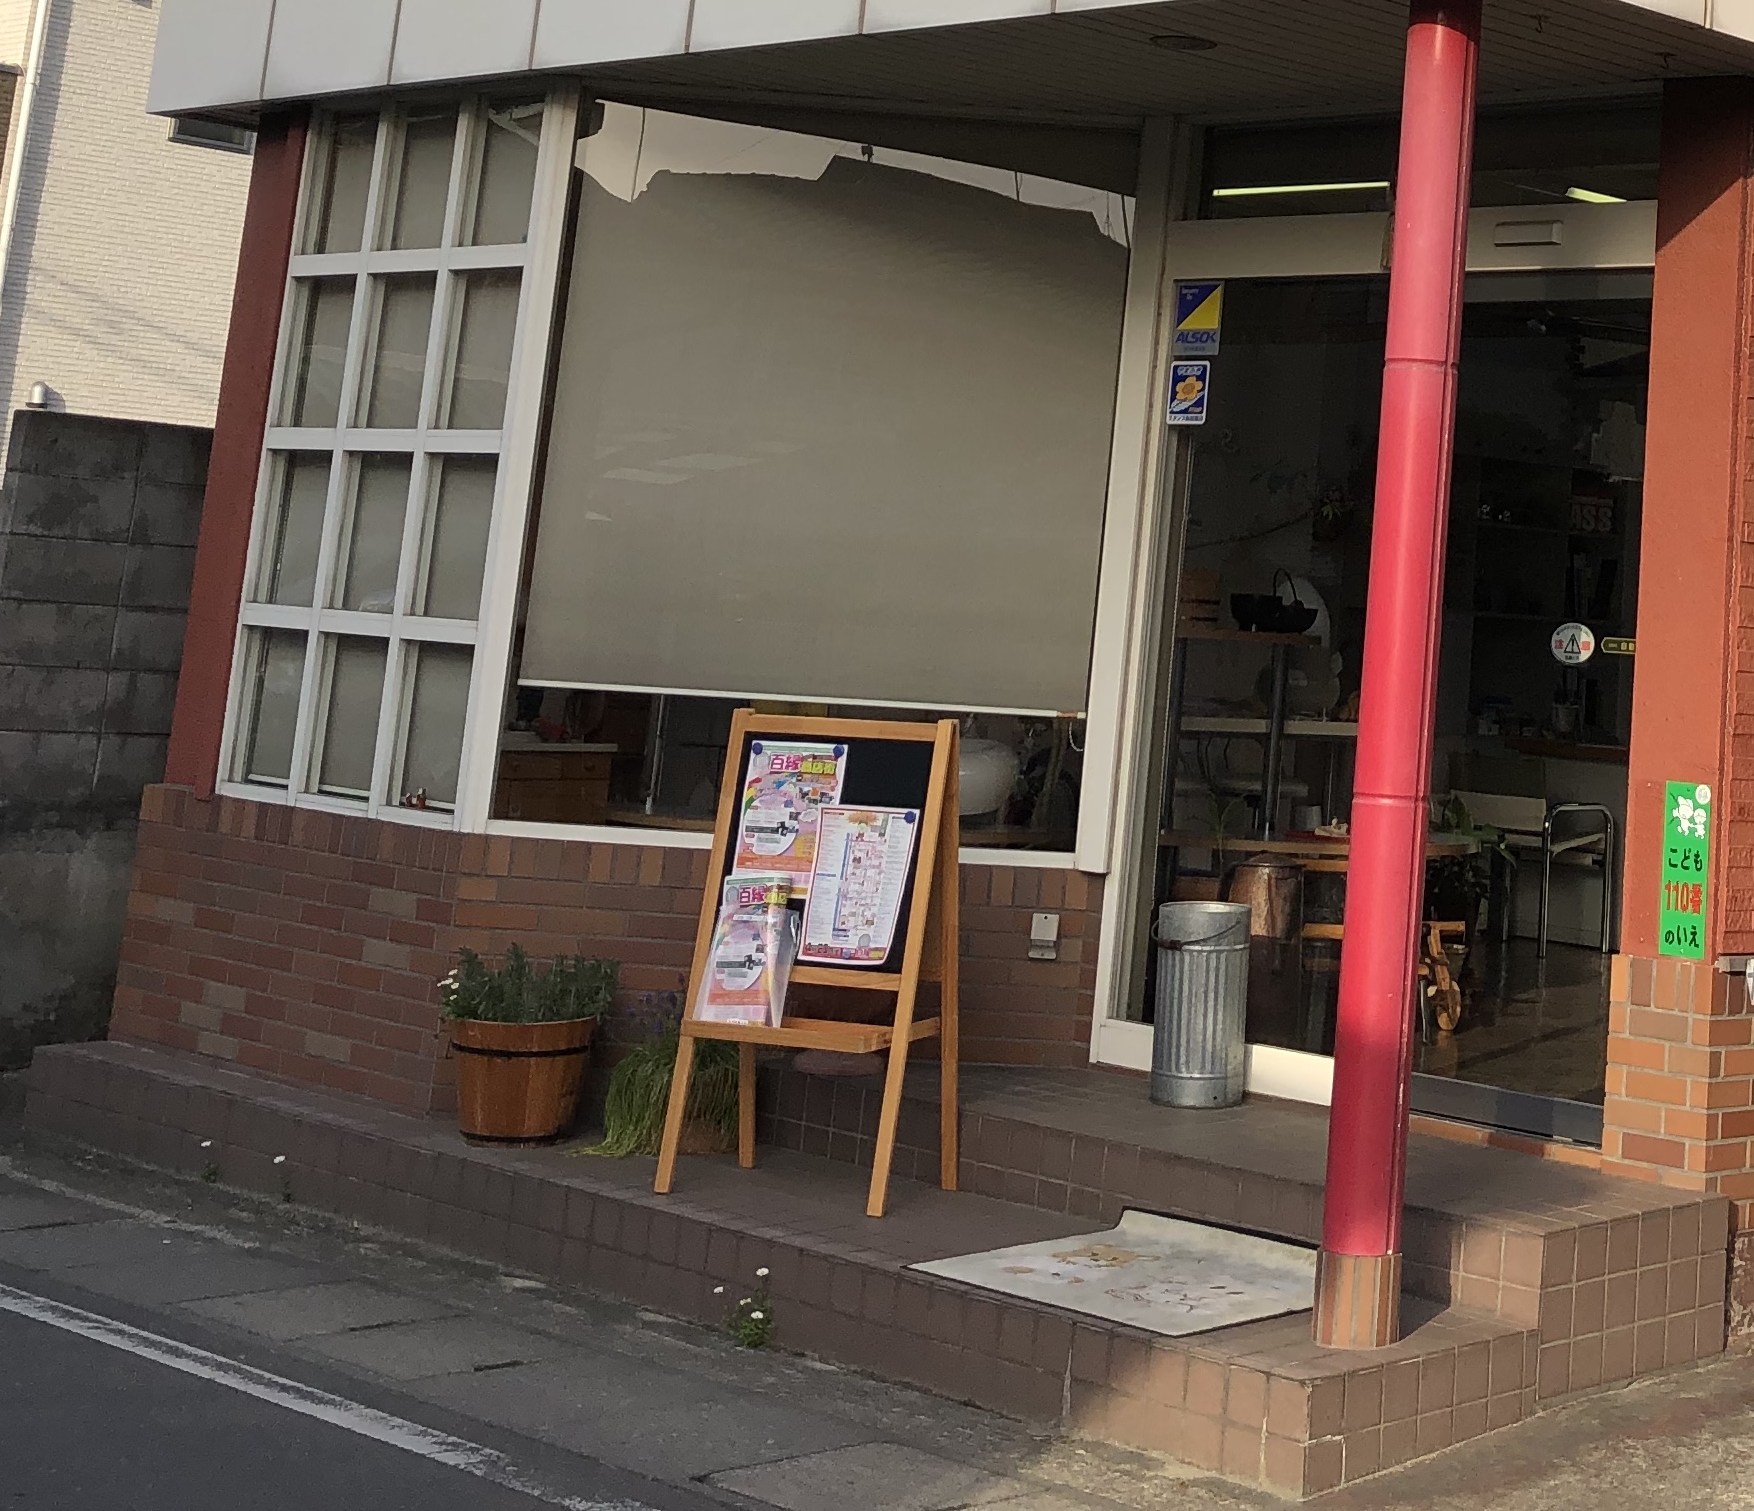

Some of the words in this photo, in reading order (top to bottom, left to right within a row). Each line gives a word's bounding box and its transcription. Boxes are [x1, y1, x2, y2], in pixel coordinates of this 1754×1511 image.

[1175, 331, 1217, 344] ALSOK
[1668, 847, 1703, 872] こども
[1664, 879, 1704, 916] 110番
[1664, 924, 1700, 949] のいえ
